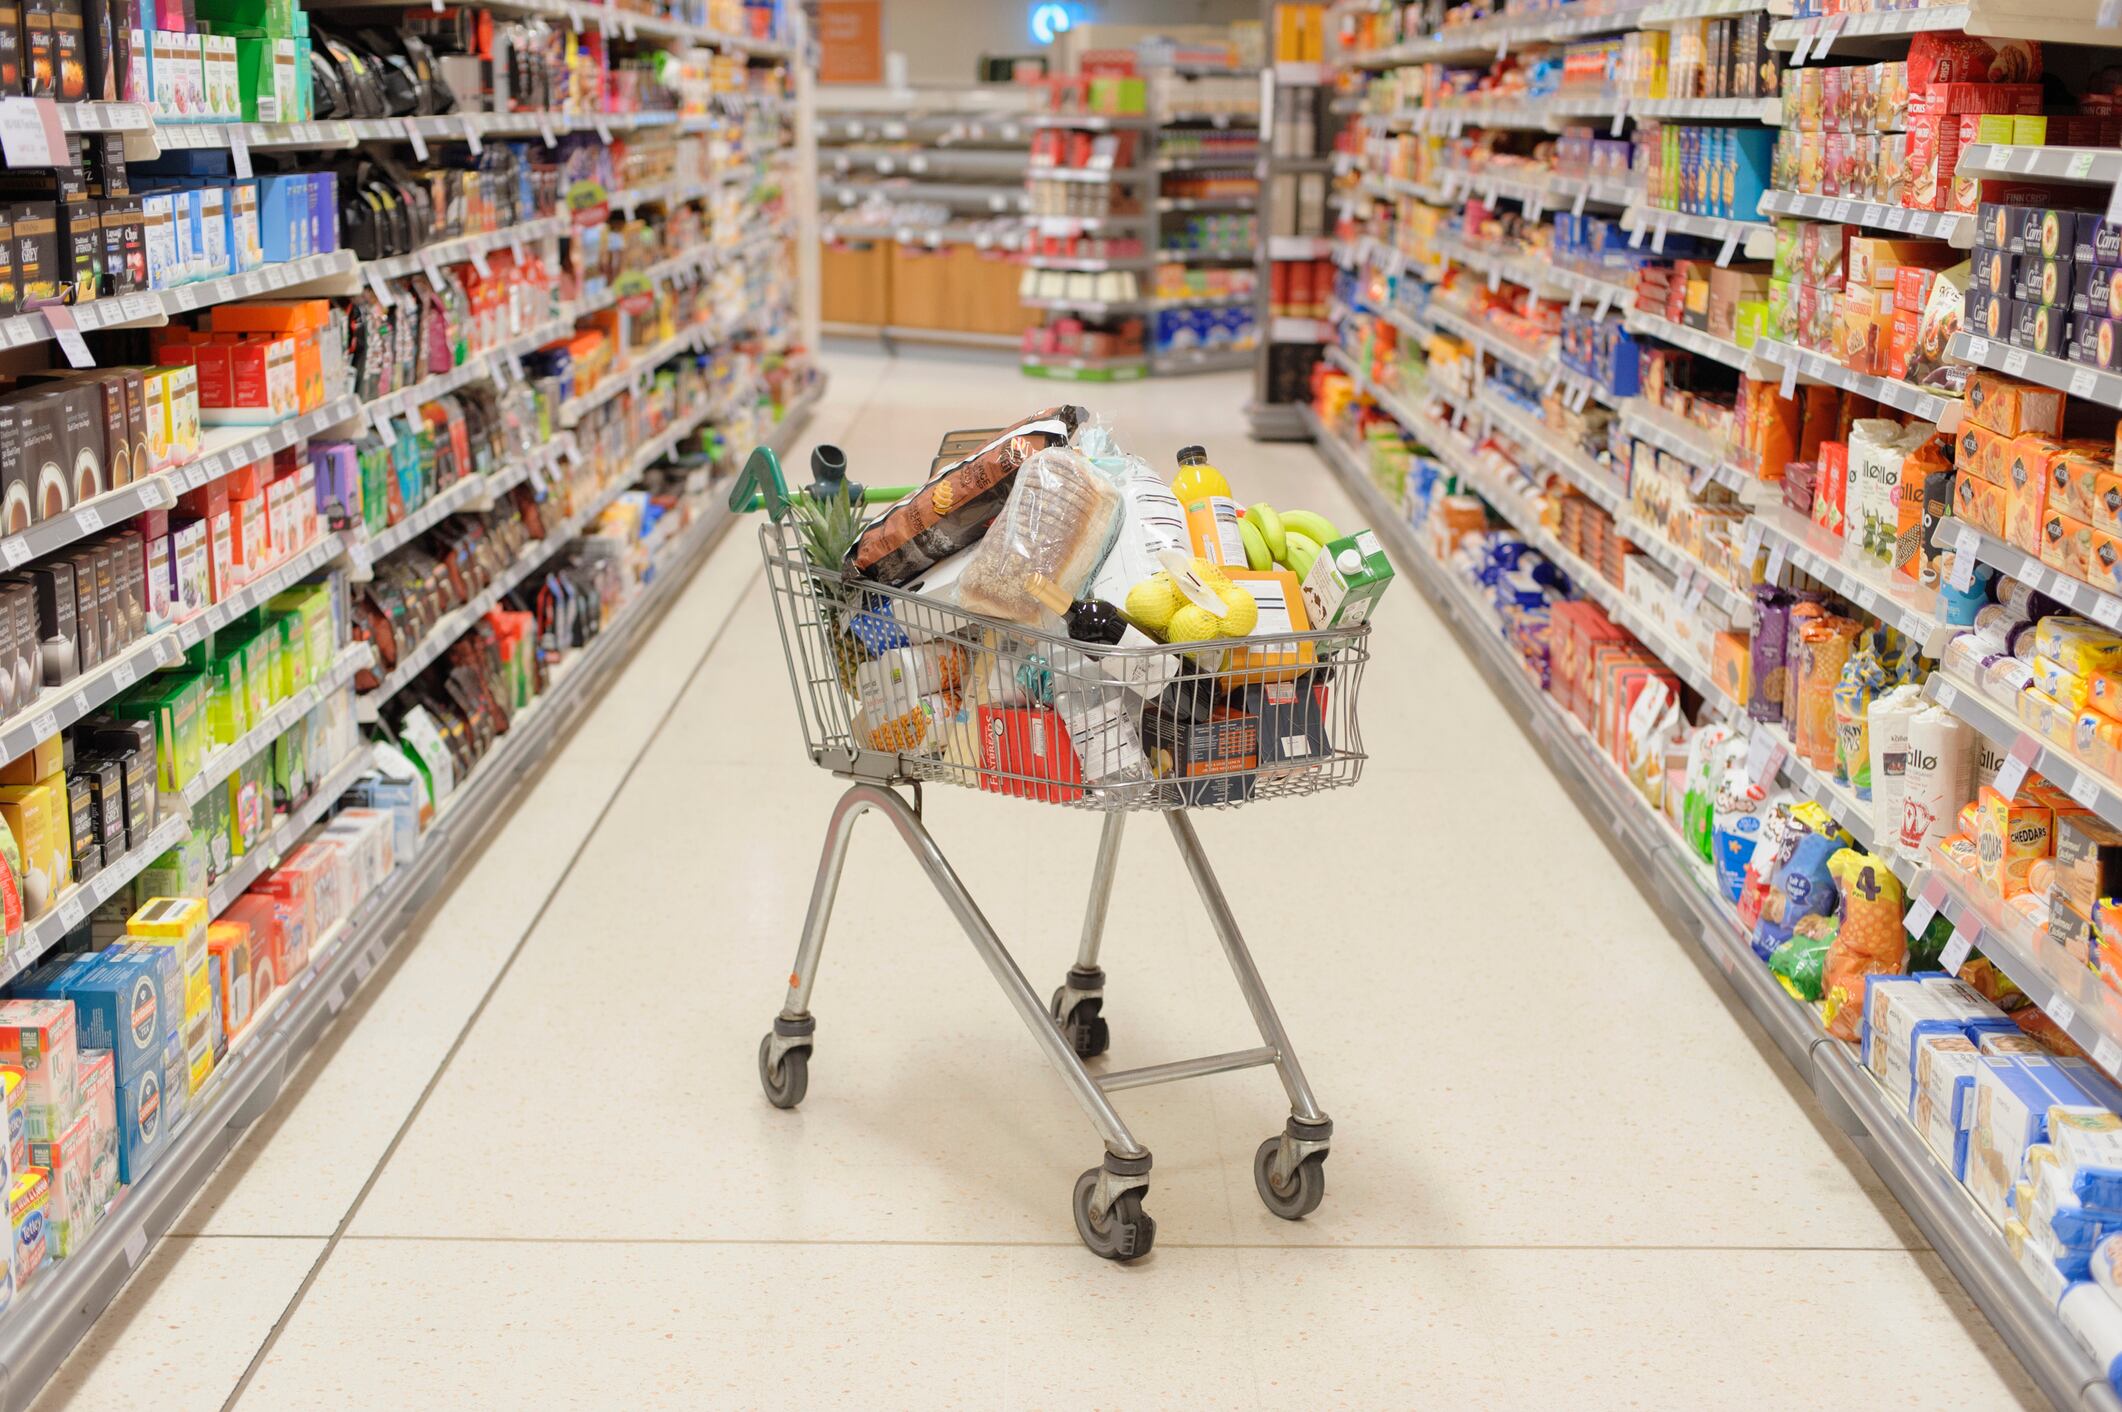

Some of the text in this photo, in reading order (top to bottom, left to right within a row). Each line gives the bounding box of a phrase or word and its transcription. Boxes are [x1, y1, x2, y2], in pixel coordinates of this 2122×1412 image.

[1939, 61, 1950, 82] CRISP
[2006, 192, 2048, 203] FINN CRISP
[2010, 827, 2047, 843] CHEDDARS
[1856, 866, 1882, 902] 4
